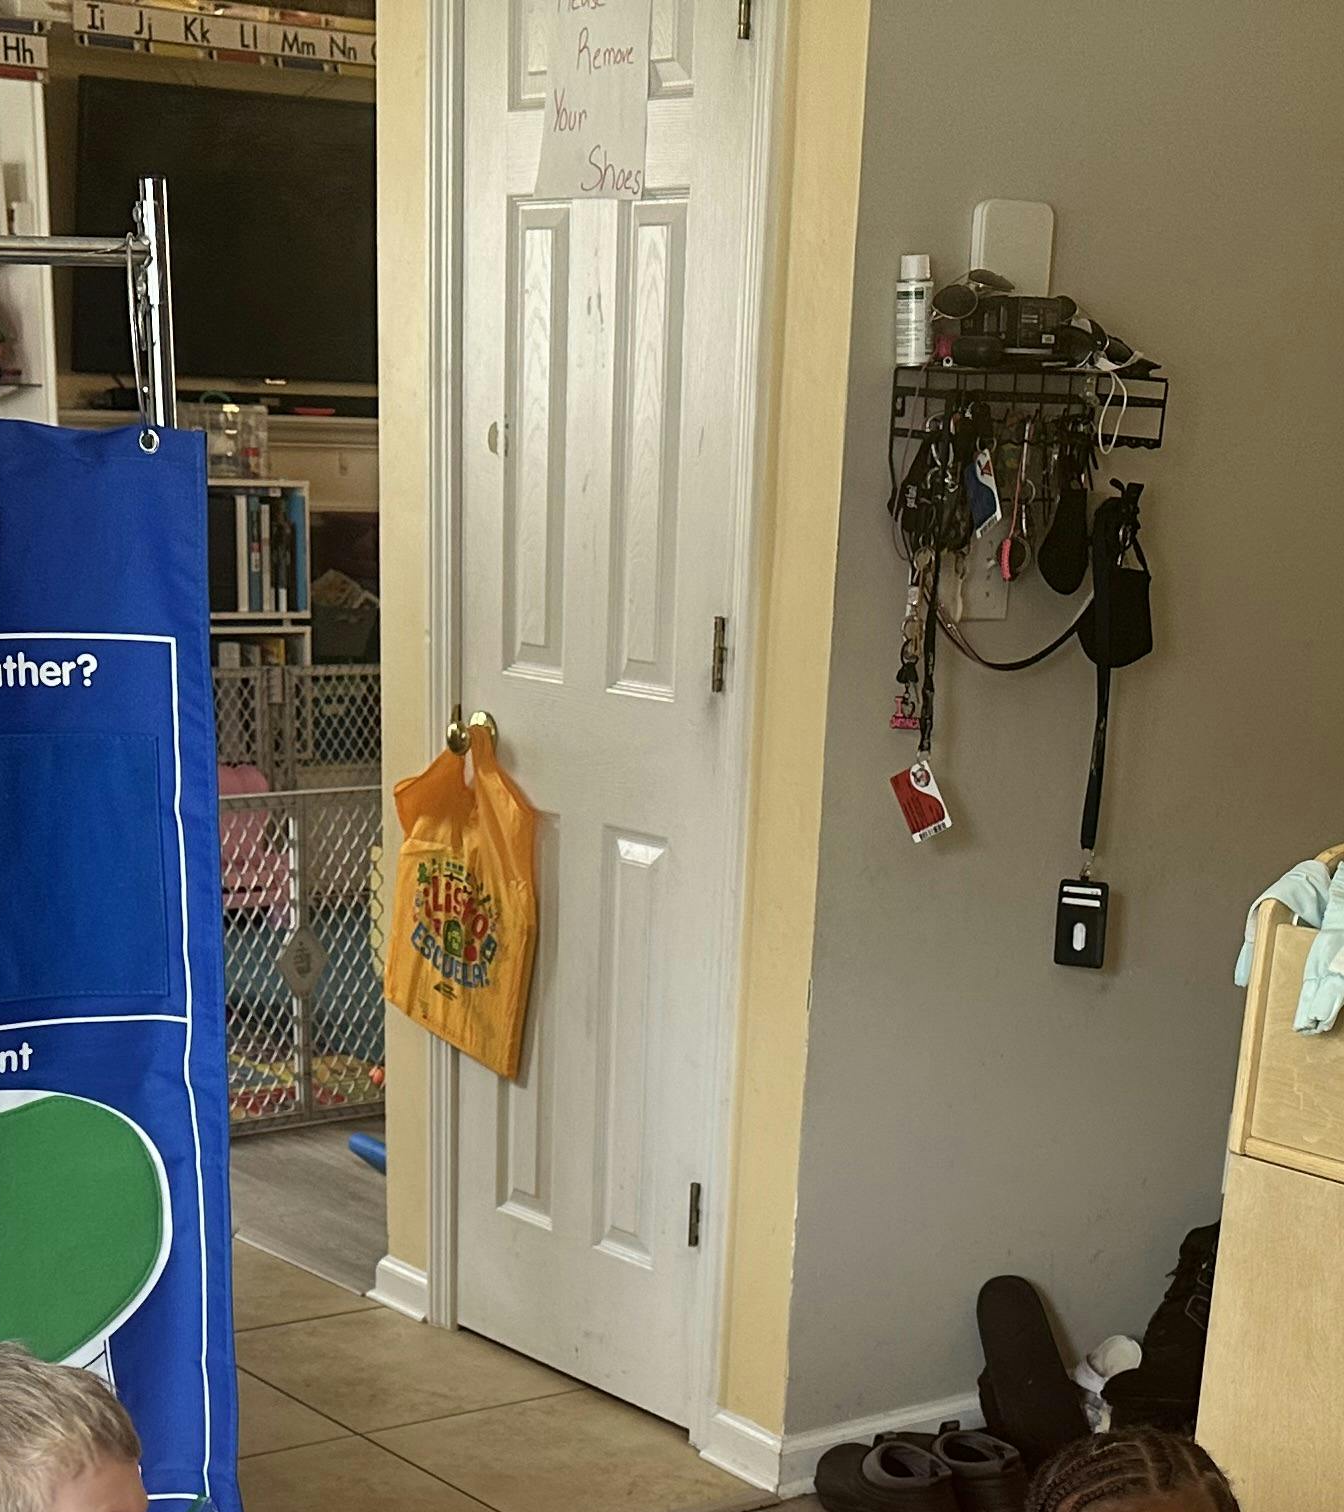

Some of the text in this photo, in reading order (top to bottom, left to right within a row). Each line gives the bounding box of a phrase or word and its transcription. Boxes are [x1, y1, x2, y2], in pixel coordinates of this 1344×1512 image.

[4, 35, 34, 65] Hh
[87, 4, 105, 31] Ii
[134, 10, 152, 47] Jj
[184, 15, 210, 44] Kk
[240, 23, 257, 49] Ll
[281, 30, 316, 57] Mm
[329, 36, 357, 61] Nn
[576, 27, 634, 75] Remove
[553, 87, 587, 132] Your
[580, 144, 641, 195] Shoes
